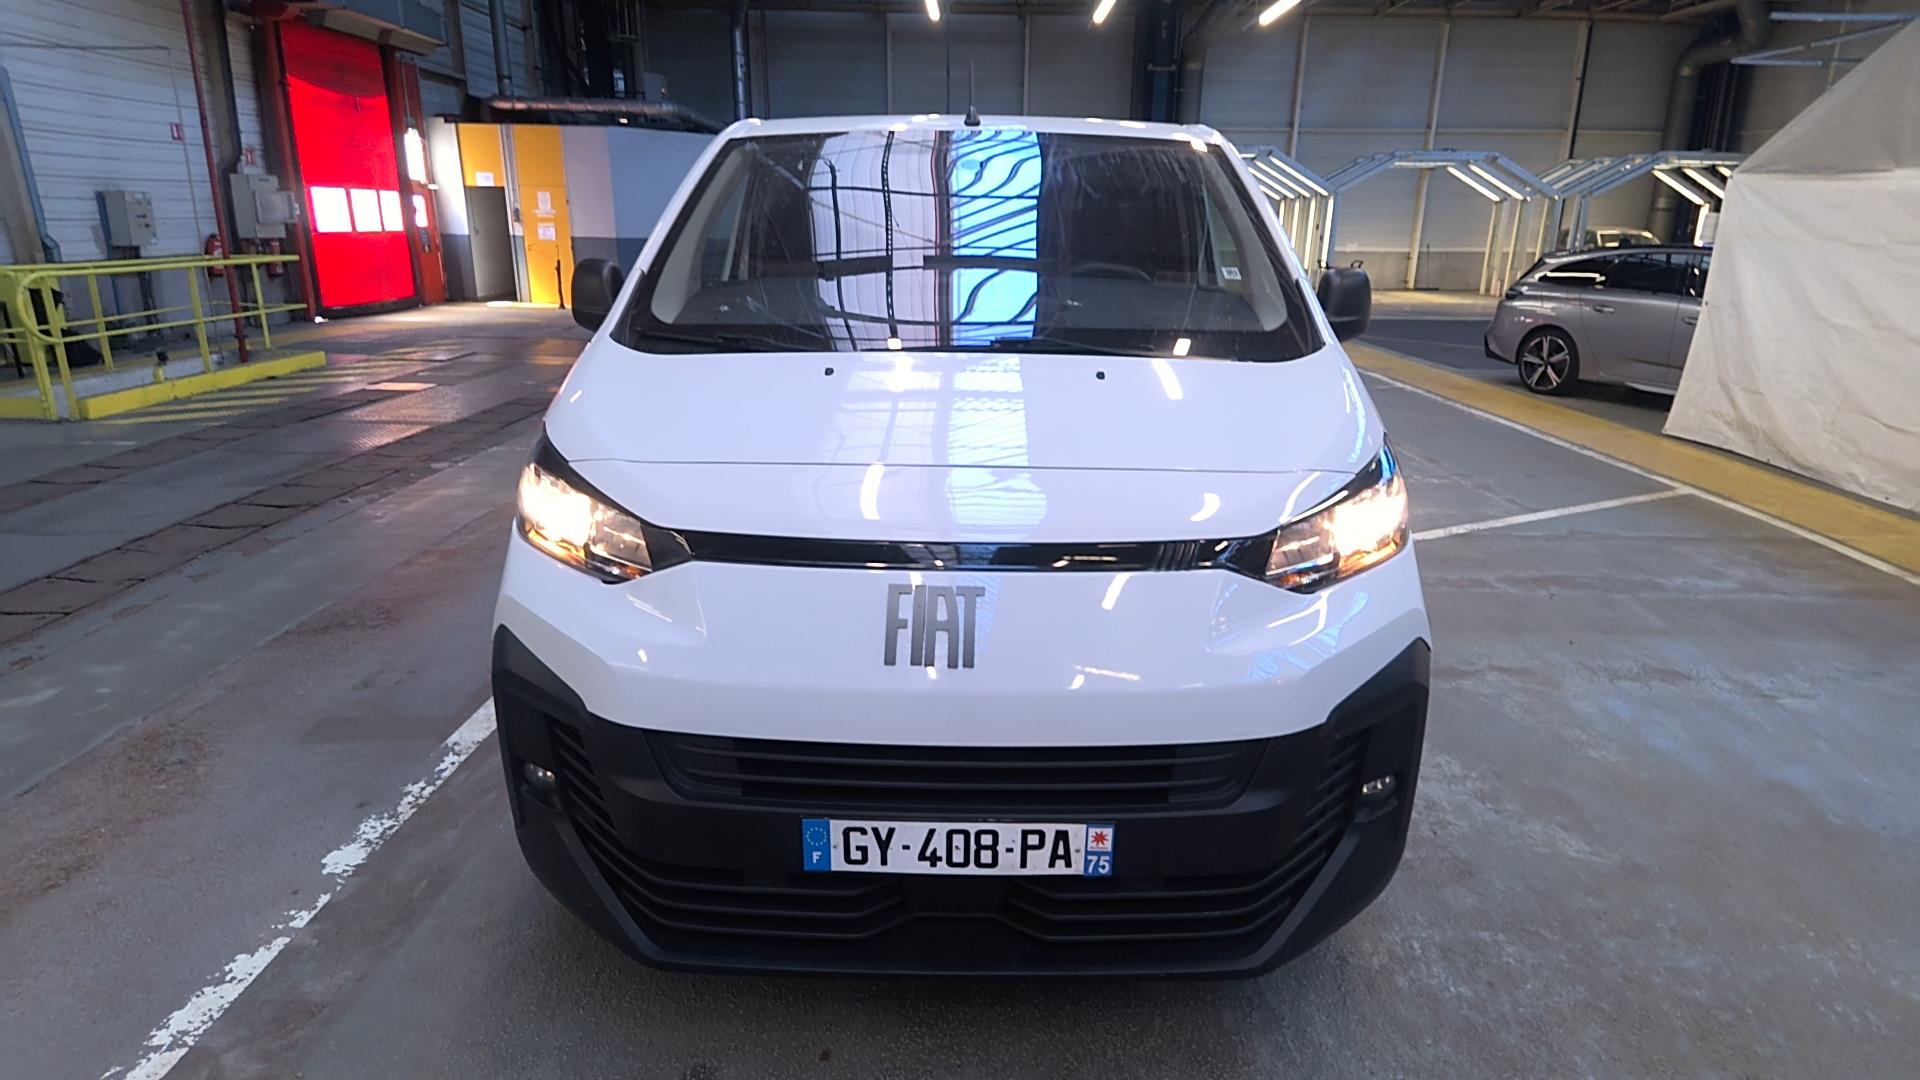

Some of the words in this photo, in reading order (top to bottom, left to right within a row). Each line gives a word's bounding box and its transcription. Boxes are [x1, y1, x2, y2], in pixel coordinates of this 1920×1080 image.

[884, 584, 985, 669] FIAT
[812, 851, 822, 864] F
[842, 826, 1073, 869] GY-408-PA
[1087, 855, 1110, 874] 75
